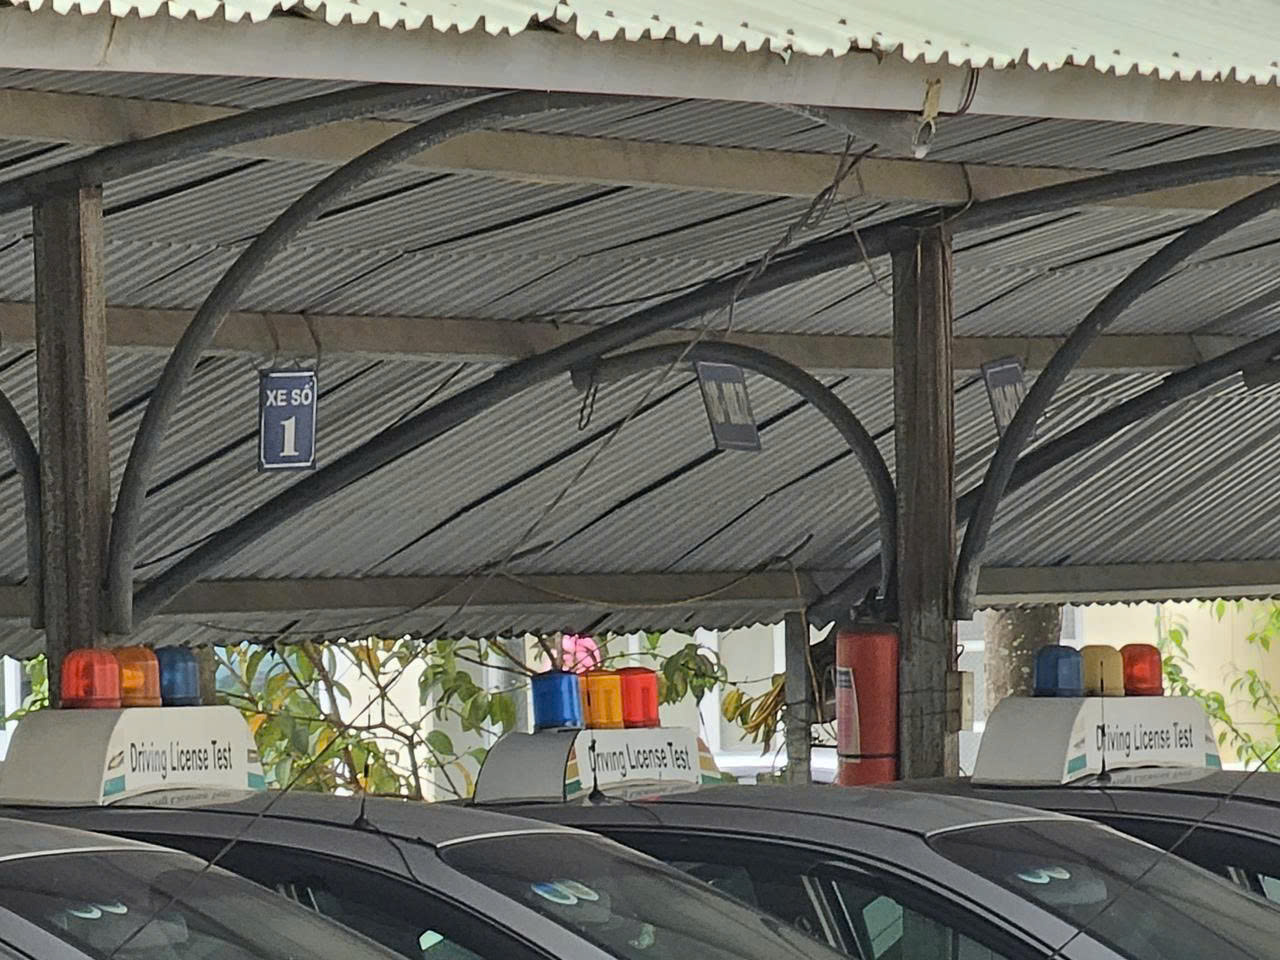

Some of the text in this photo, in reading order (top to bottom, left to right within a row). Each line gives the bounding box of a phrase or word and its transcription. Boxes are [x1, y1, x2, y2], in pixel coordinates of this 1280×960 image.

[266, 381, 313, 407] XE SỐ
[280, 415, 299, 457] 1
[626, 743, 668, 770] License
[667, 741, 692, 771] Test
[1096, 722, 1194, 758] Driving License Test
[130, 740, 233, 781] Driving License Test
